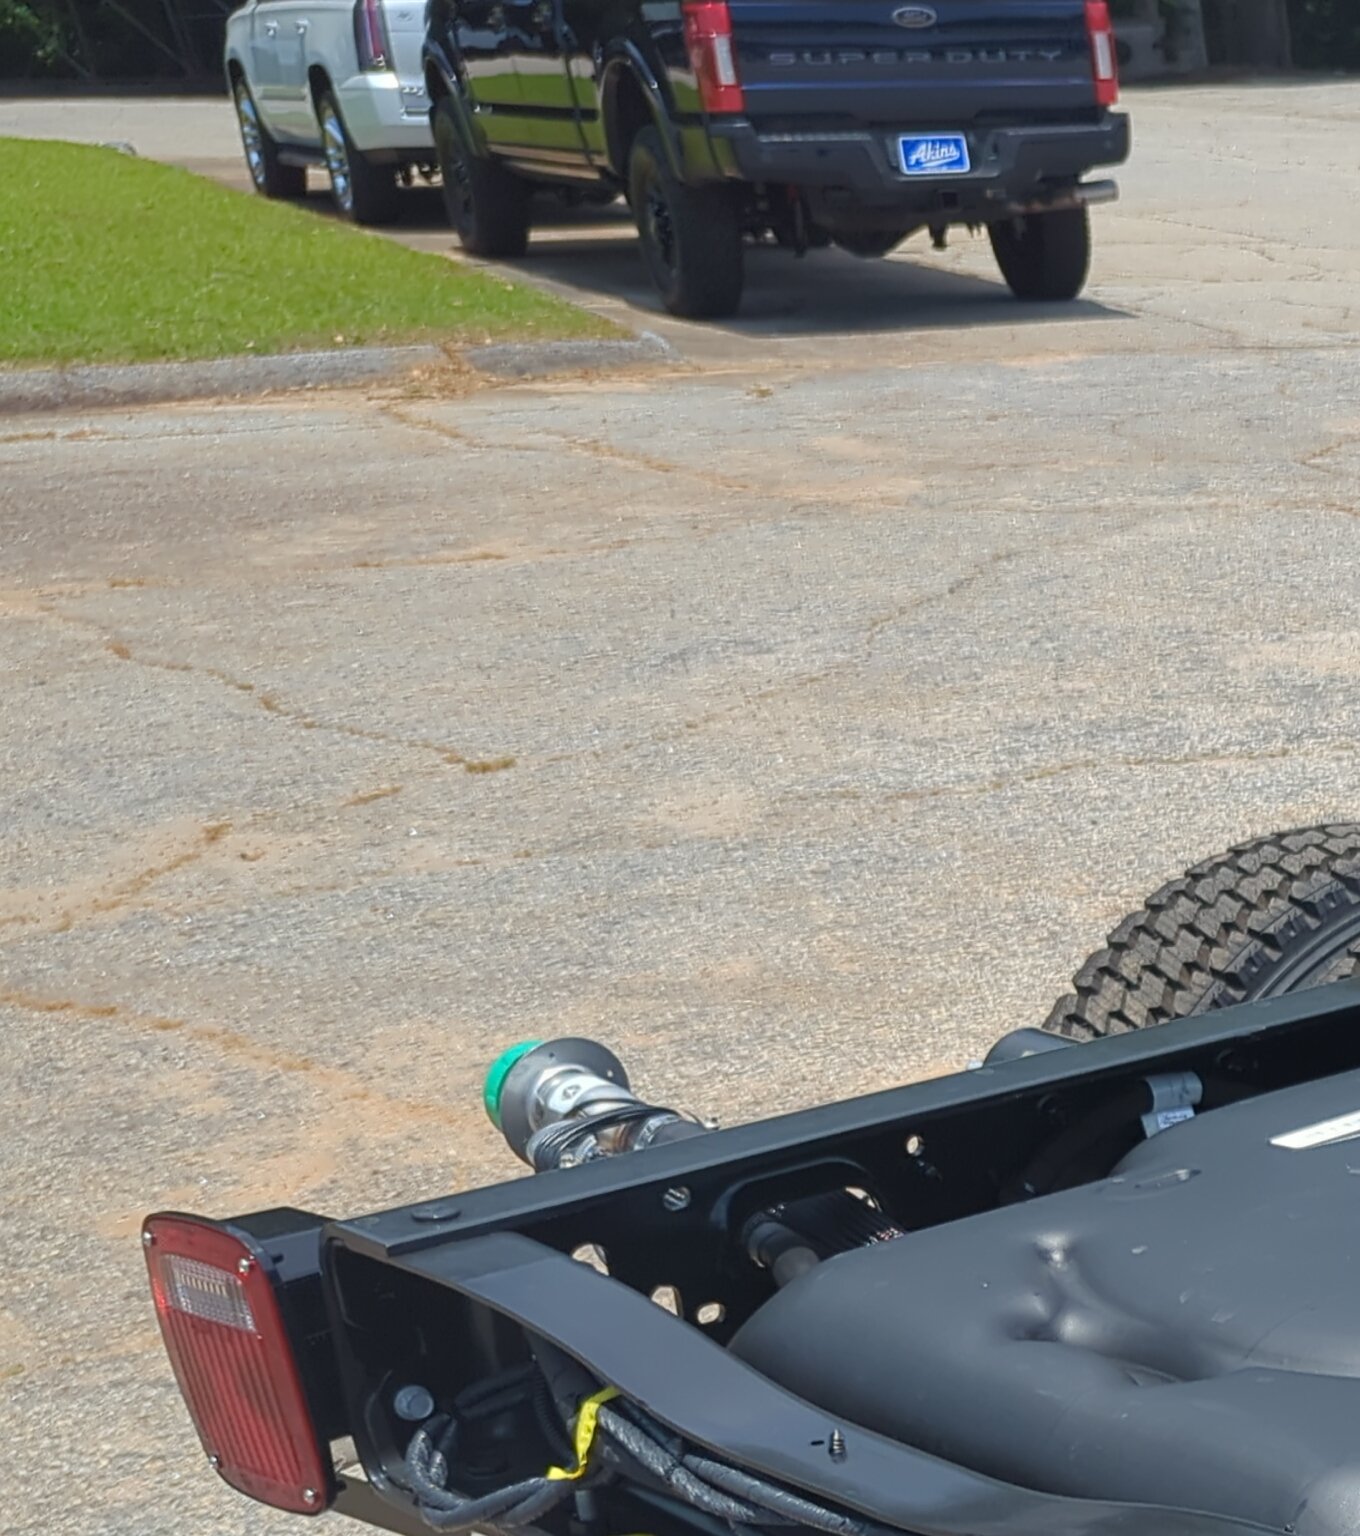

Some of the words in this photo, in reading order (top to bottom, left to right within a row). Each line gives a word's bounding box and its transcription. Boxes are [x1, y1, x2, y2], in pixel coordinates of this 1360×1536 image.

[769, 52, 931, 65] SUPER
[947, 50, 1061, 63] DUTY
[908, 141, 959, 166] Akins
